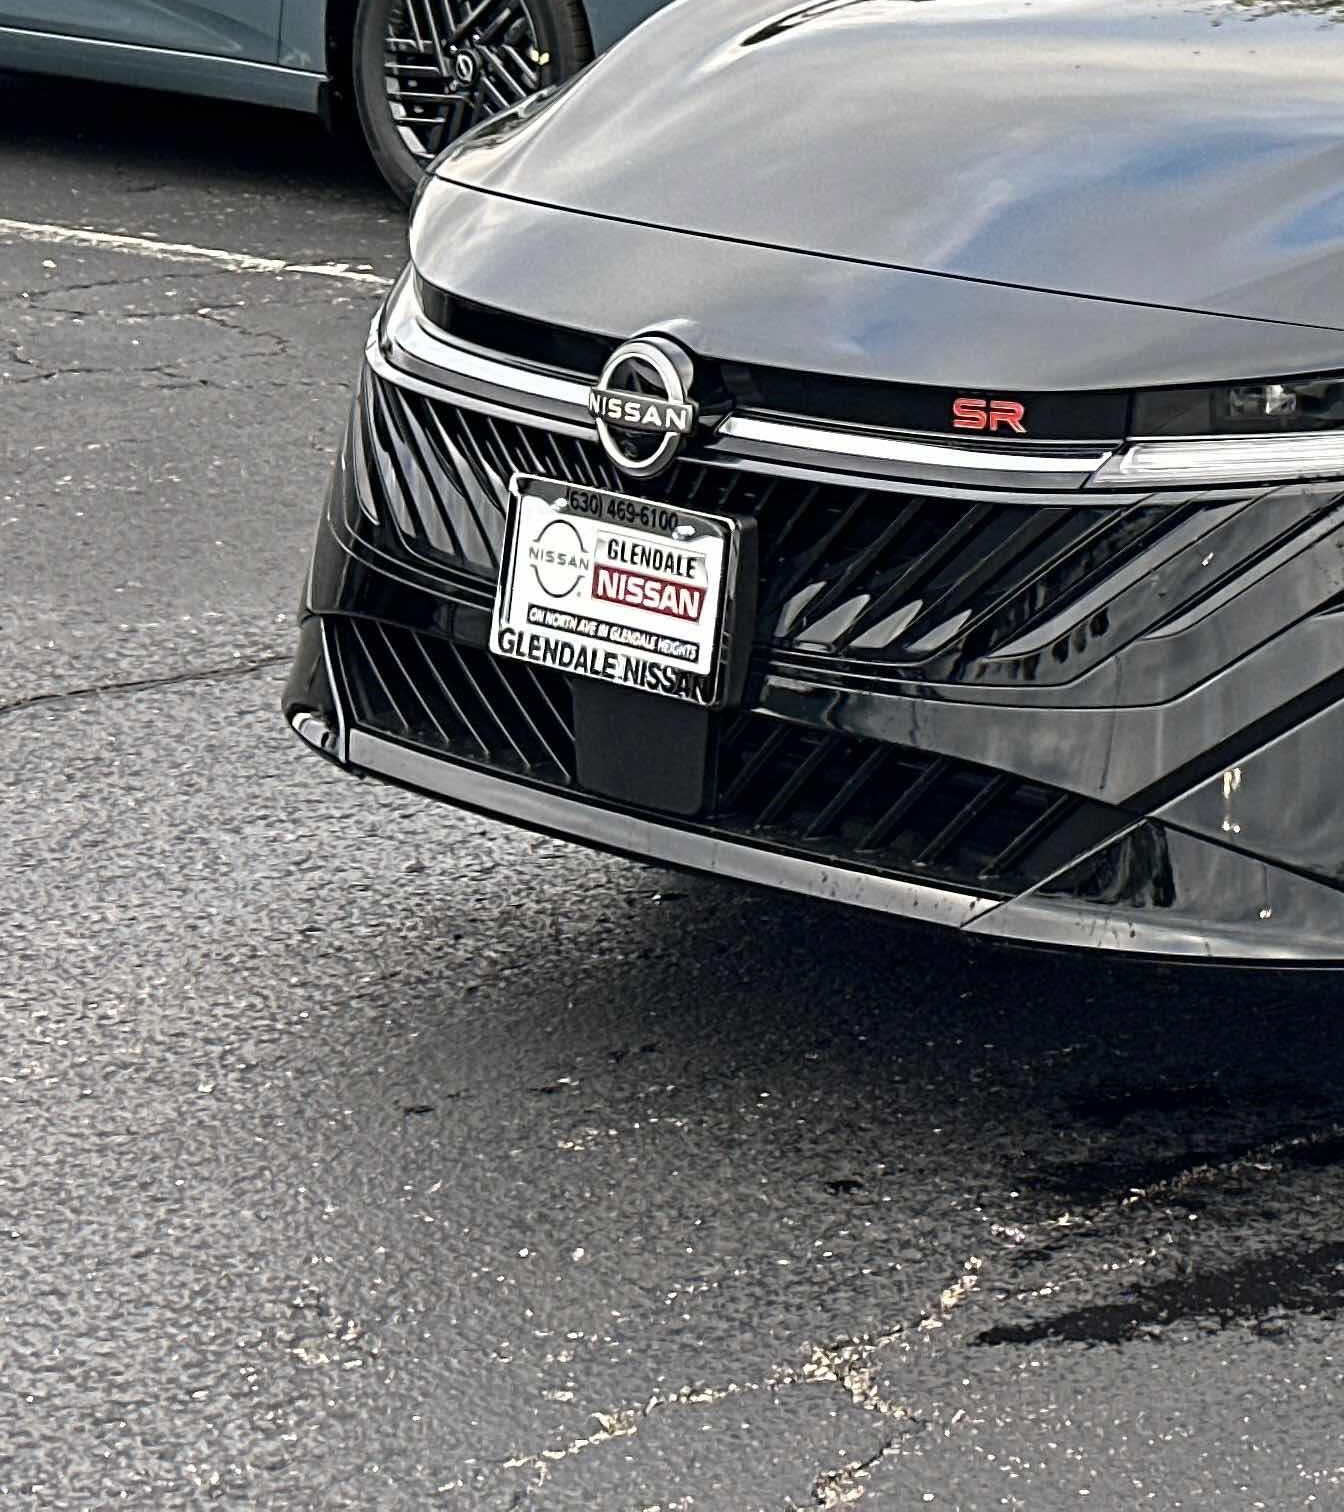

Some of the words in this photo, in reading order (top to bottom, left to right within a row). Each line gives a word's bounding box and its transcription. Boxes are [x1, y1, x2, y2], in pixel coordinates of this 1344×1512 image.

[589, 392, 686, 429] NISSAN
[953, 397, 1027, 434] SR
[607, 502, 679, 531] 469-6100
[528, 546, 590, 571] NISSAN
[607, 538, 697, 580] GLENDALE
[597, 569, 700, 619] NISSAN
[500, 627, 618, 679] GLENDALE
